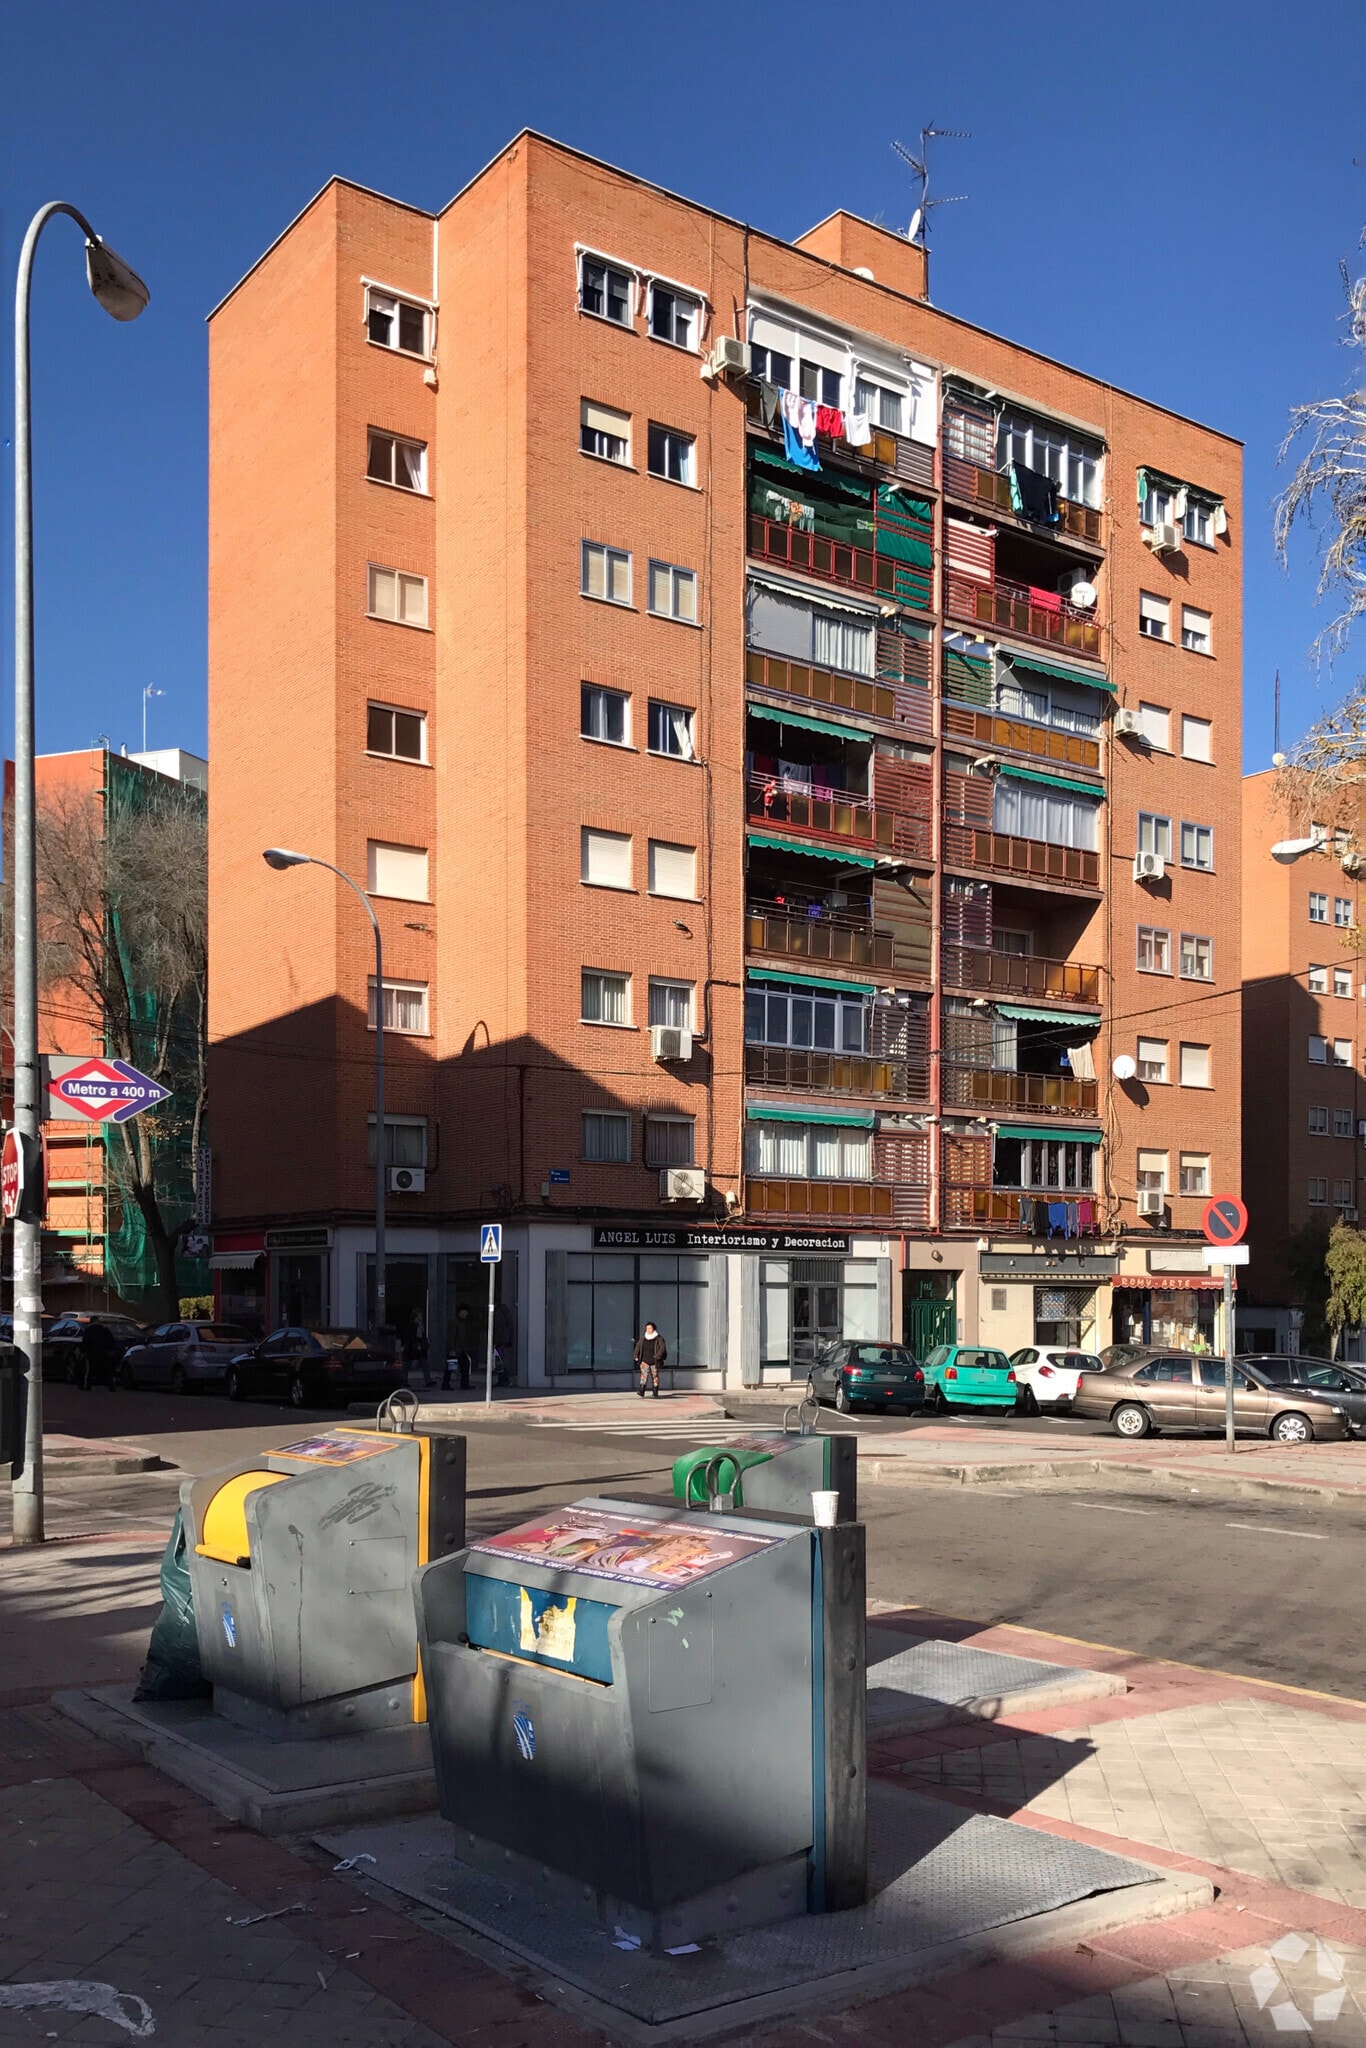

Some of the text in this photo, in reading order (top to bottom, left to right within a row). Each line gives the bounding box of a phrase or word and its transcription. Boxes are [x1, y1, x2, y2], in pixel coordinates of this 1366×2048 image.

[68, 1083, 161, 1098] Metro a 400 m
[3, 1161, 18, 1186] STOP
[599, 1232, 846, 1248] ANGEL LUIS Interiorismo y Decoracion
